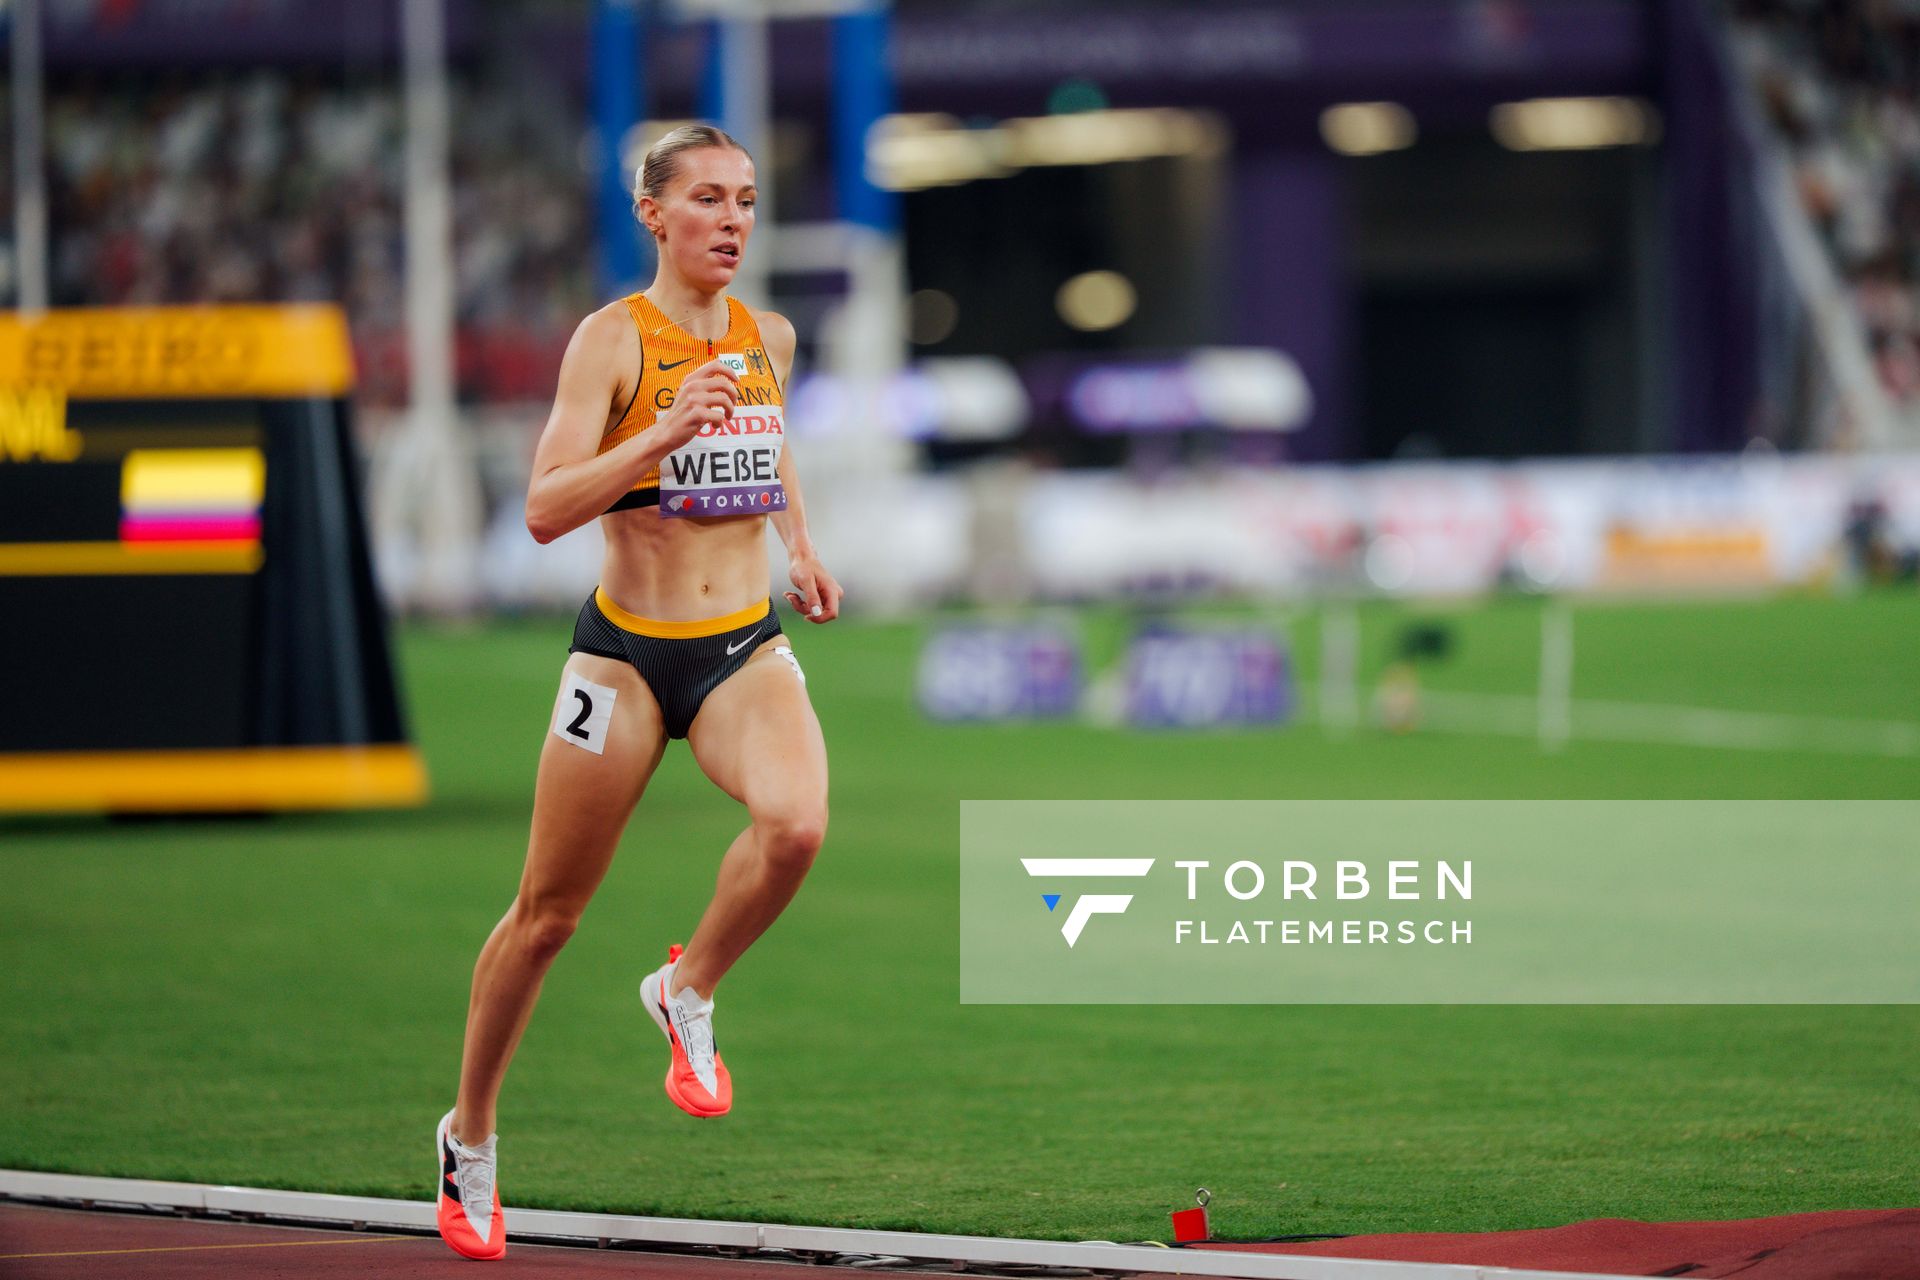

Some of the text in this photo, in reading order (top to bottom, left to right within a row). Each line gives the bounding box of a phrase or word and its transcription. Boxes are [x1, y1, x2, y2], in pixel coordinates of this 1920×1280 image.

[655, 387, 772, 409] GANY
[696, 415, 783, 438] ONDA
[567, 689, 592, 740] 2
